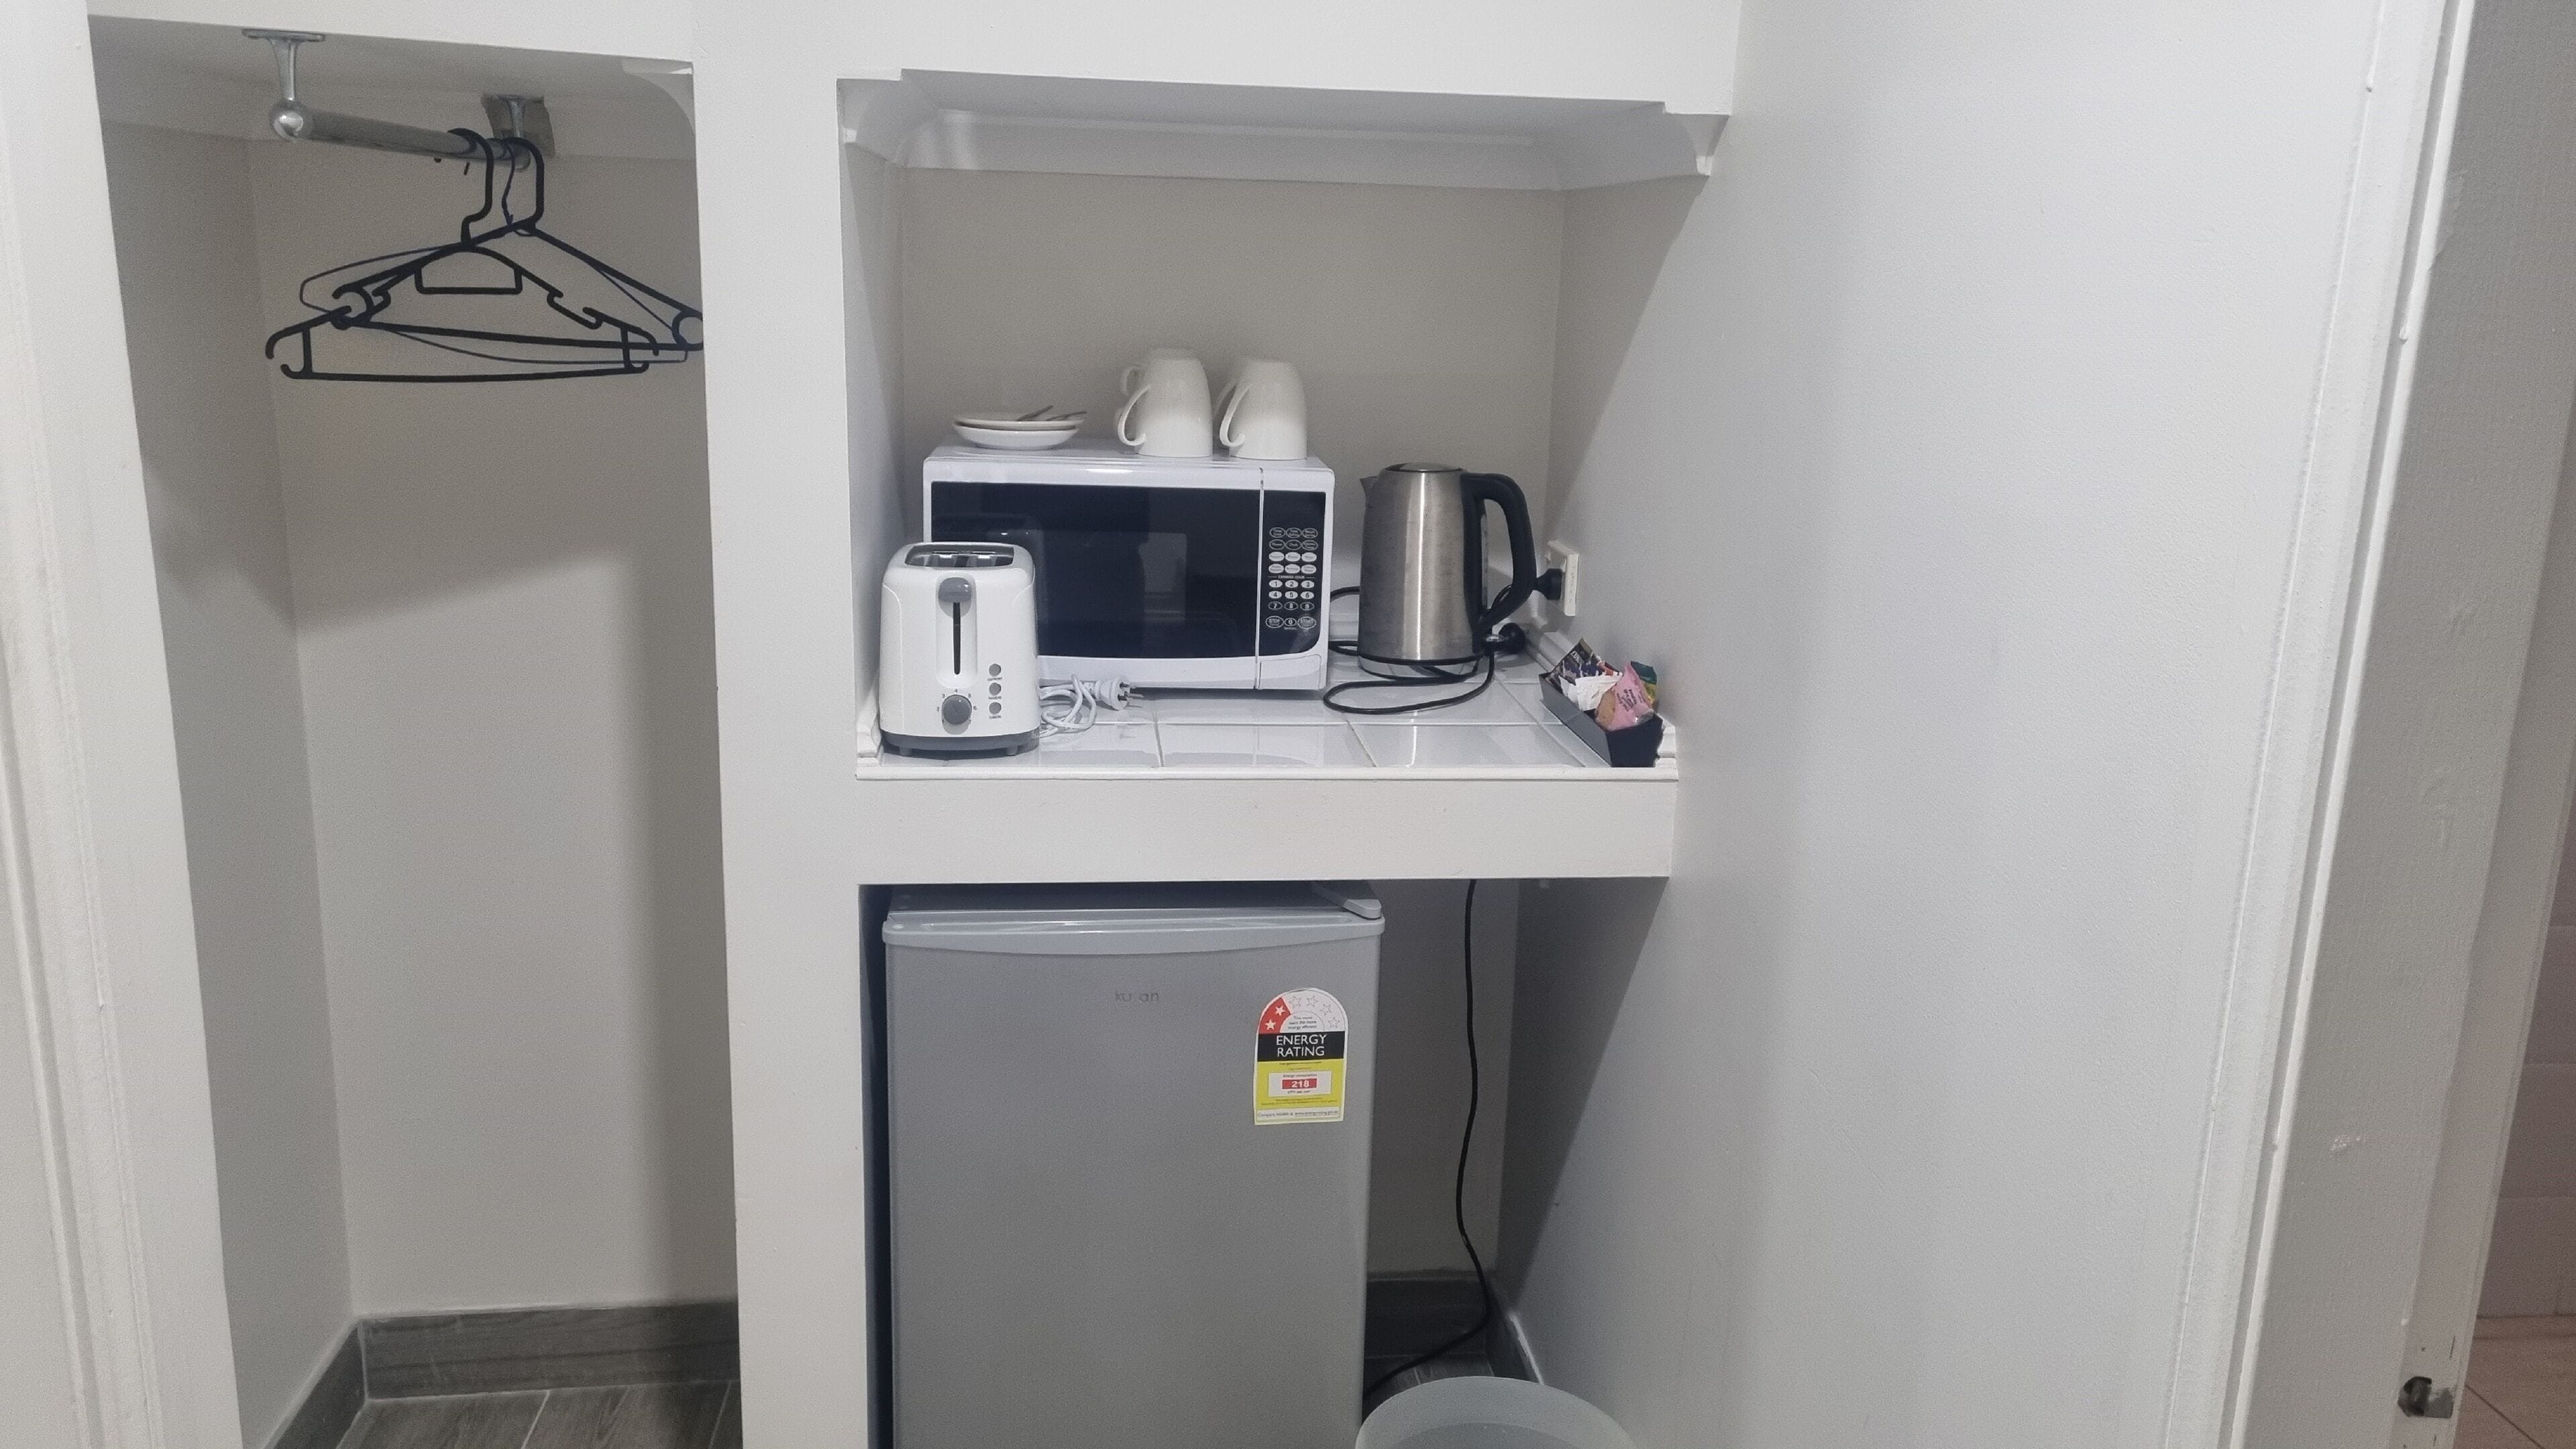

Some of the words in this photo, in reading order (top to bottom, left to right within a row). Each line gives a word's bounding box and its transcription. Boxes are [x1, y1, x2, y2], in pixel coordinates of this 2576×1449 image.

[1276, 1034, 1327, 1046] ENERGY
[1277, 1046, 1325, 1057] RATING
[1291, 1080, 1309, 1088] 218
